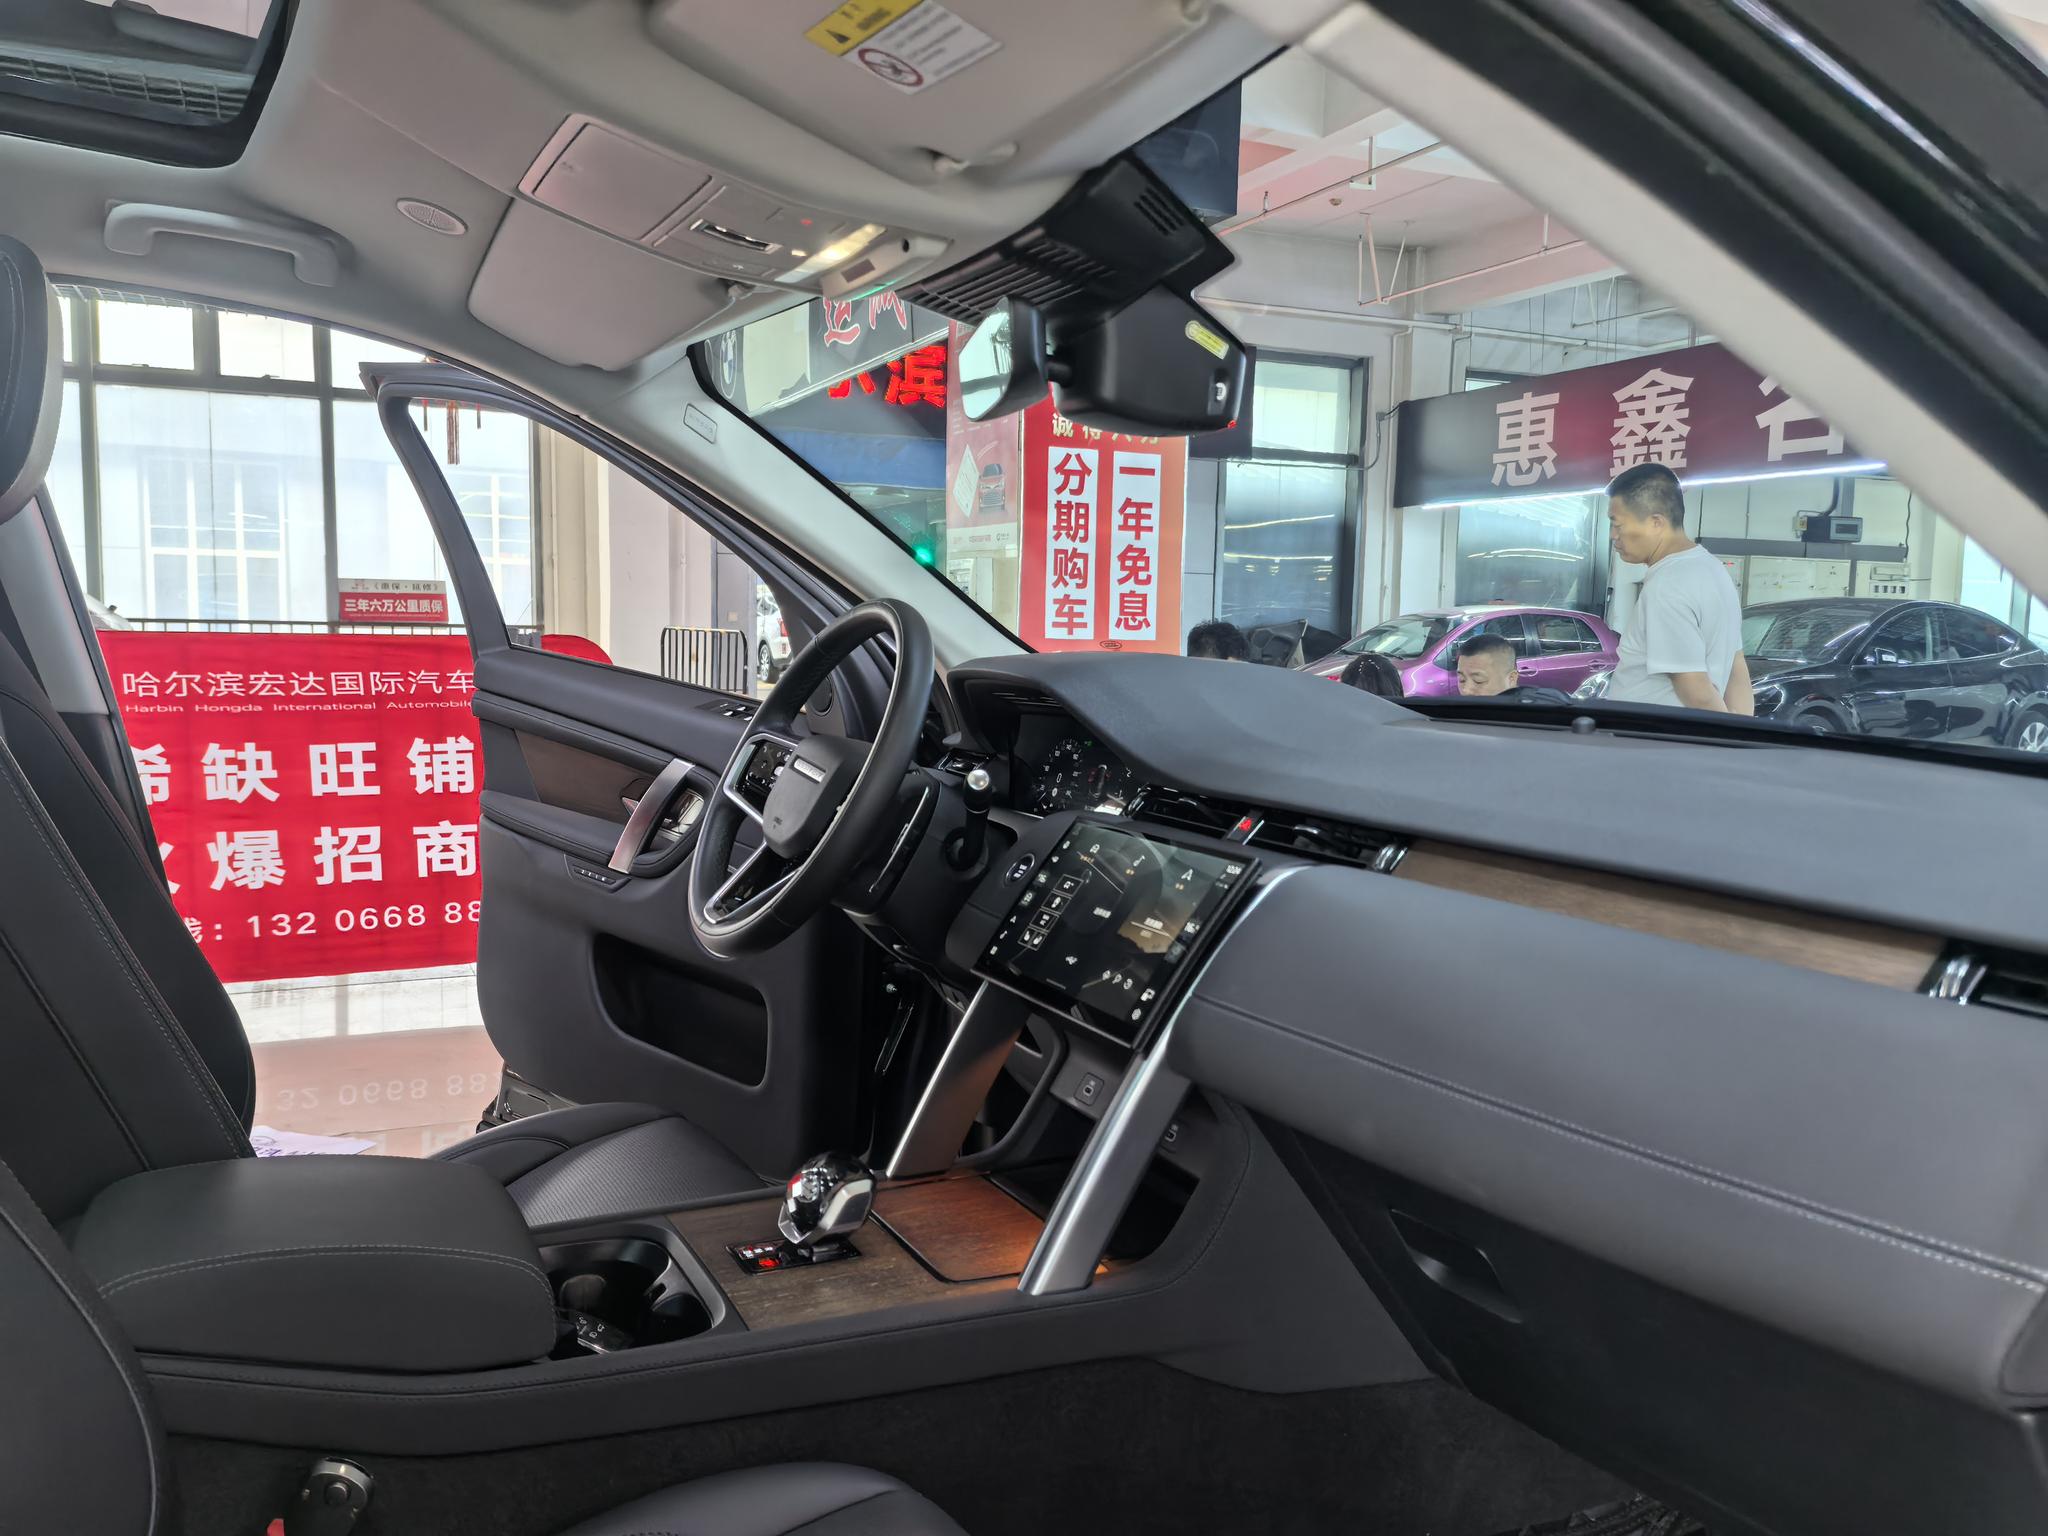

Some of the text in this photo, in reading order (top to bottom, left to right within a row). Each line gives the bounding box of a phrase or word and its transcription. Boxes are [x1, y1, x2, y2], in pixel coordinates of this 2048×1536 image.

[1052, 453, 1092, 635] 分期购车
[1115, 466, 1155, 631] 一年免息
[344, 599, 443, 613] 三年六万公里质保
[122, 669, 473, 698] 哈尔滨宏达国际汽车
[125, 704, 184, 713] Harbin
[195, 703, 263, 714] Hongda
[273, 702, 376, 711] International
[247, 911, 317, 938] 132
[335, 904, 426, 932] 0668
